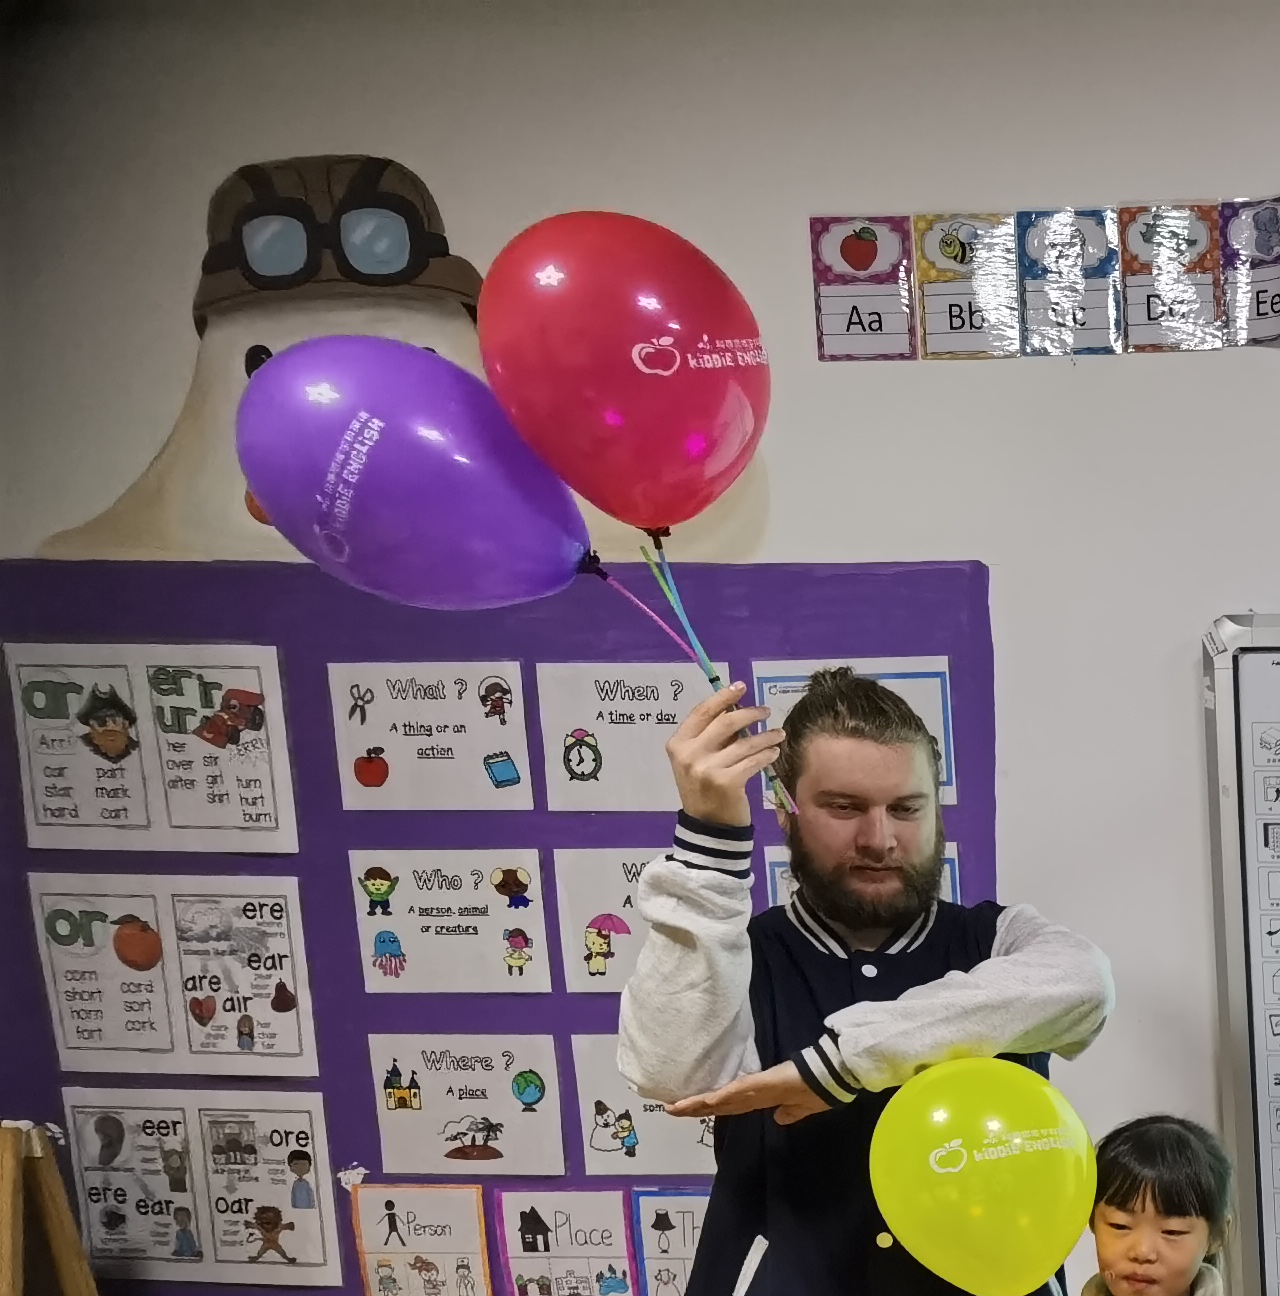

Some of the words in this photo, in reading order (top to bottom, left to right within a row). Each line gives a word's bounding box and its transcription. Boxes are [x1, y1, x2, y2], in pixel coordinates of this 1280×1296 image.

[845, 304, 883, 335] Aa
[948, 302, 985, 331] Bb
[151, 667, 193, 697] er
[386, 677, 446, 700] What
[454, 678, 467, 700] ?
[595, 679, 659, 701] When
[670, 679, 684, 701] ?
[21, 680, 84, 720] ar
[156, 705, 197, 735] ur
[596, 711, 605, 721] A
[609, 710, 636, 722] time
[639, 712, 651, 722] or
[656, 710, 677, 723] day
[389, 722, 398, 733] A
[402, 721, 433, 736] thing
[436, 725, 449, 734] or
[453, 725, 466, 734] an
[417, 744, 454, 757] action
[412, 869, 462, 891] Who
[470, 869, 483, 891] ?
[242, 902, 284, 921] ere
[408, 906, 415, 915] A
[623, 896, 633, 908] A
[45, 908, 108, 947] or
[247, 953, 289, 971] ear
[184, 974, 222, 992] are
[222, 996, 254, 1013] air
[421, 1050, 495, 1071] Where
[502, 1050, 515, 1071] ?
[446, 1086, 455, 1096] A
[458, 1085, 488, 1099] place
[142, 1119, 182, 1137] eer
[270, 1129, 310, 1147] ore
[88, 1186, 128, 1205] ere
[215, 1196, 254, 1214] oar
[135, 1198, 175, 1216] ear
[405, 1211, 453, 1238] Person
[554, 1211, 613, 1248] Place
